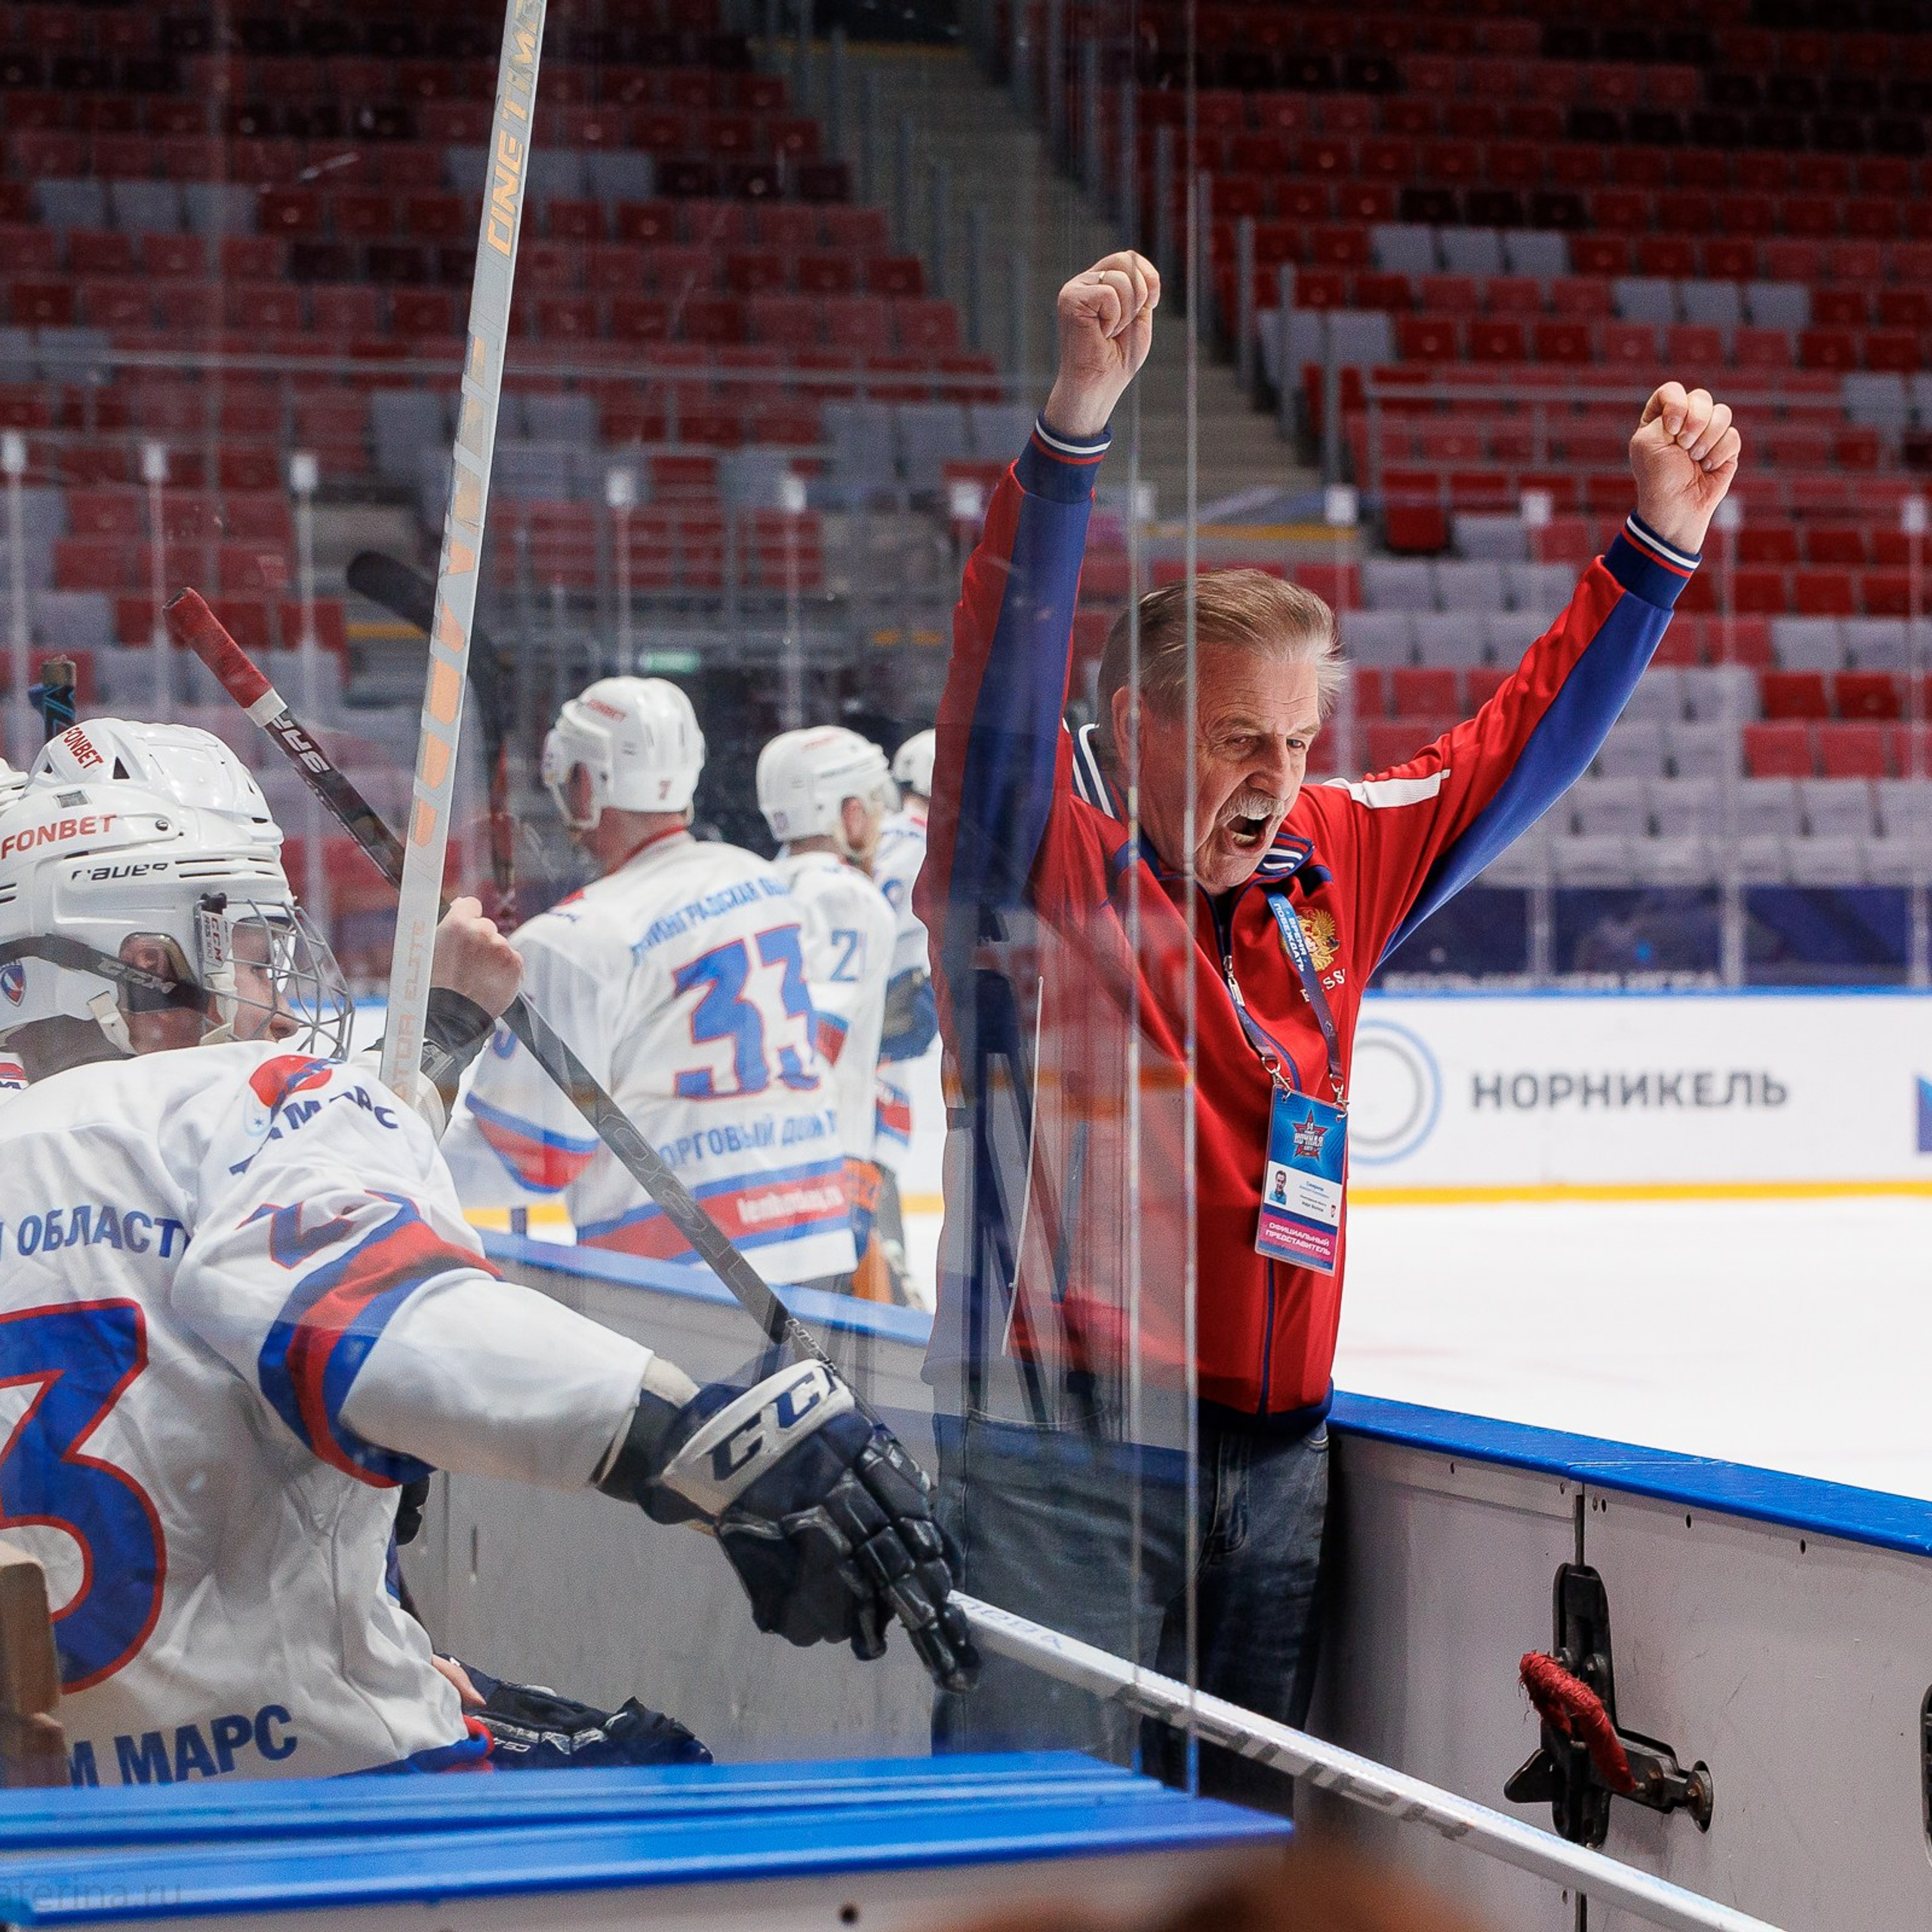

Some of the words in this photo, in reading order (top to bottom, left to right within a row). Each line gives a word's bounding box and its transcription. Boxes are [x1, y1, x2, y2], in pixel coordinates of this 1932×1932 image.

[64, 728, 103, 769] FONBET
[1, 814, 117, 859] FONBET
[1274, 902, 1306, 972] ПОБЕЖДАТЬ
[1287, 917, 1306, 956] ВРЕМЯ
[1471, 1072, 1789, 1110] НОРНИКЕЛЬ
[17, 1205, 191, 1258] ОБЛАСТ
[1266, 1229, 1331, 1256] ПРЕДСТАВИТЕЛЬ
[1269, 1221, 1330, 1247] ОФИЦИАЛЬНЫЙ
[113, 1704, 297, 1786] МАРС
